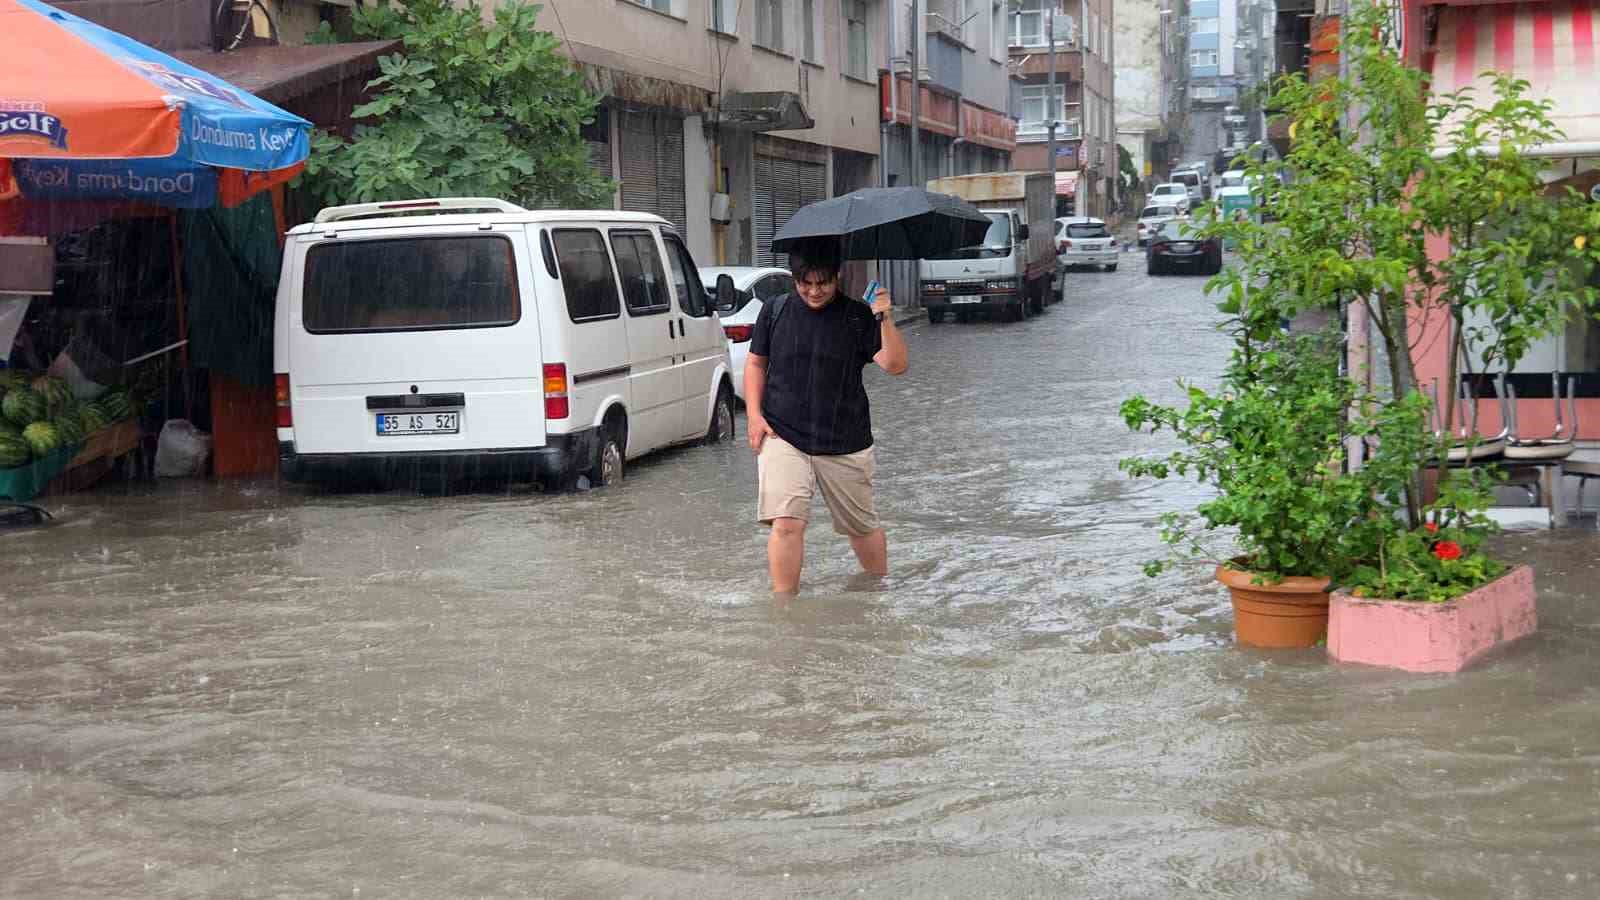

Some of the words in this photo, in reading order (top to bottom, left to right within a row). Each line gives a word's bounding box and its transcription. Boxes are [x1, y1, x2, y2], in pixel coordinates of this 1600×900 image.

[192, 115, 256, 150] Dondurma
[384, 416, 399, 430] 55
[409, 415, 423, 429] AS
[436, 414, 456, 428] 521
